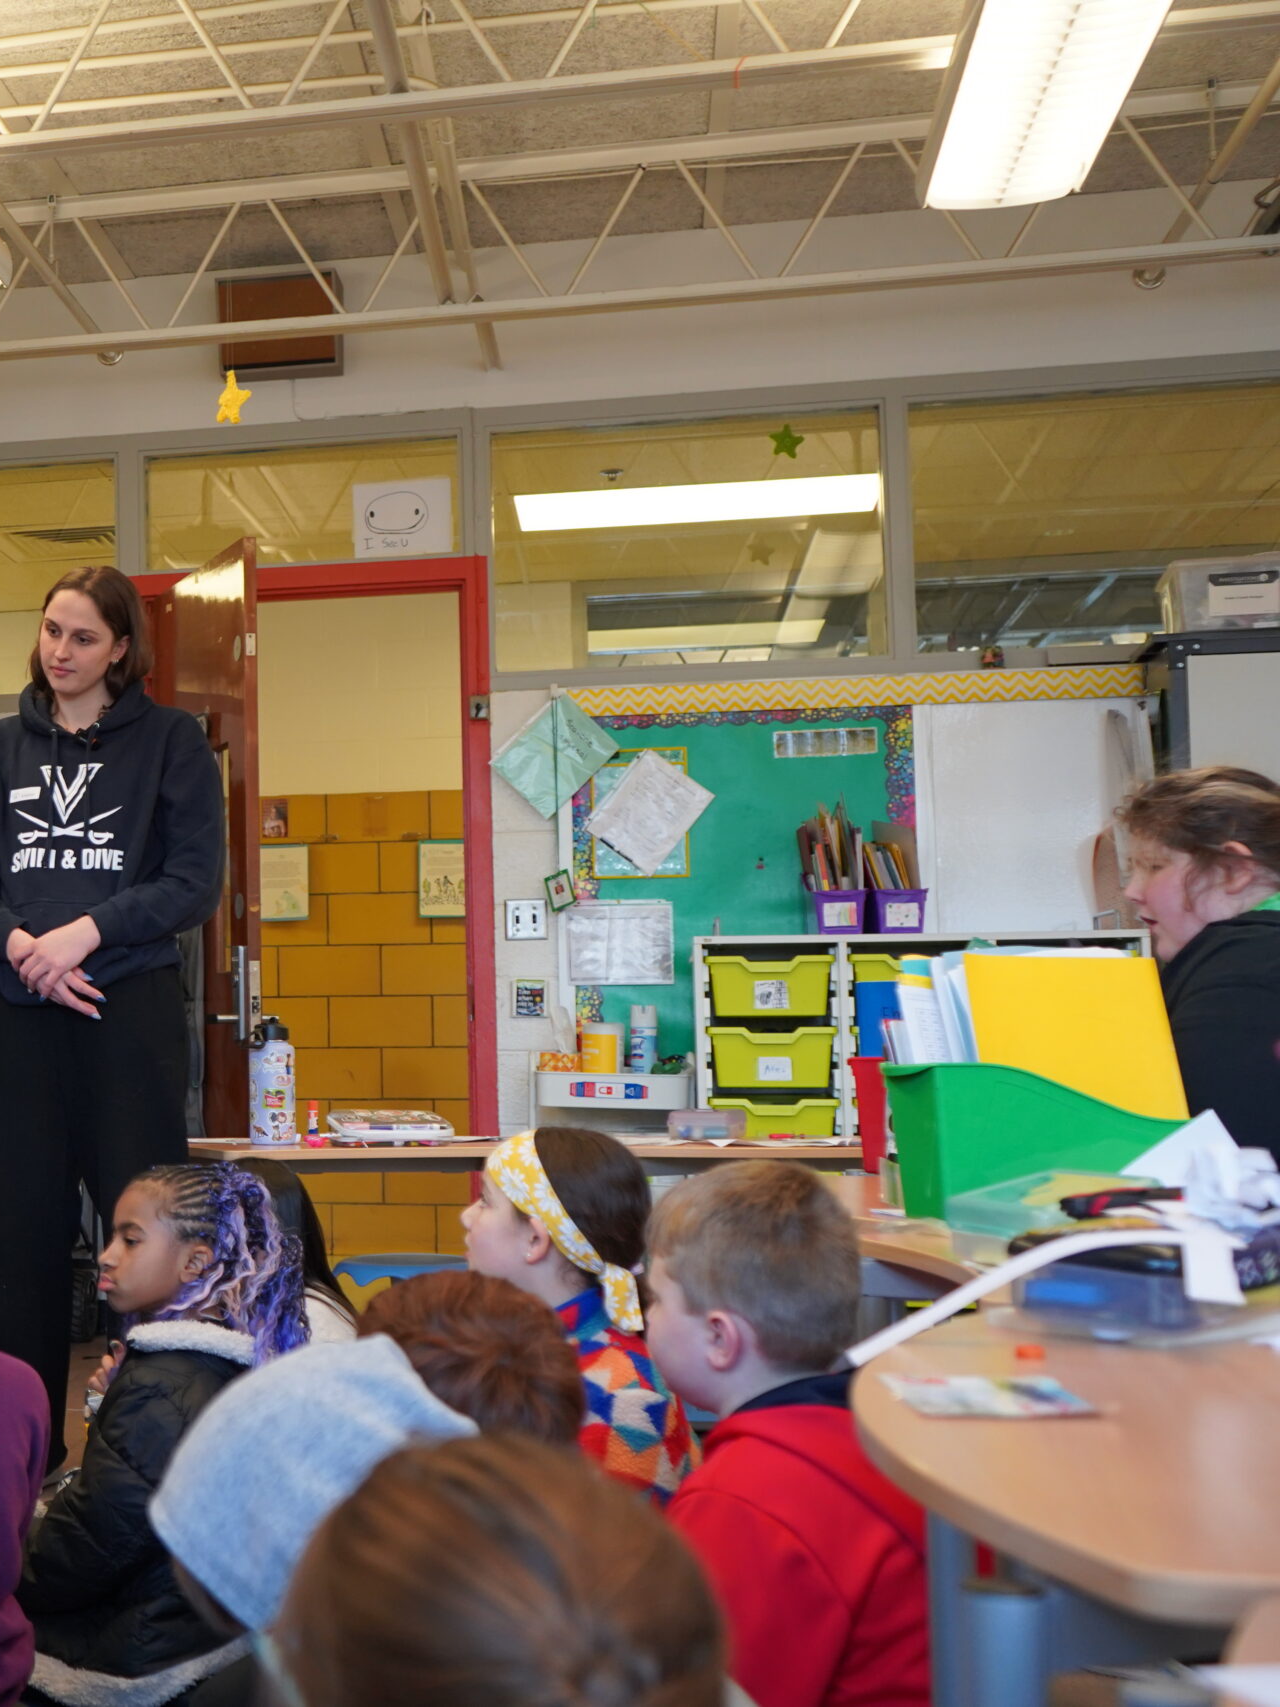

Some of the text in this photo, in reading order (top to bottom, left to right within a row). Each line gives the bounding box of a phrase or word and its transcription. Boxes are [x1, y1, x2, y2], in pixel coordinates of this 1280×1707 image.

[364, 537, 374, 550] I
[61, 848, 77, 870] &
[82, 848, 124, 871] DIVE
